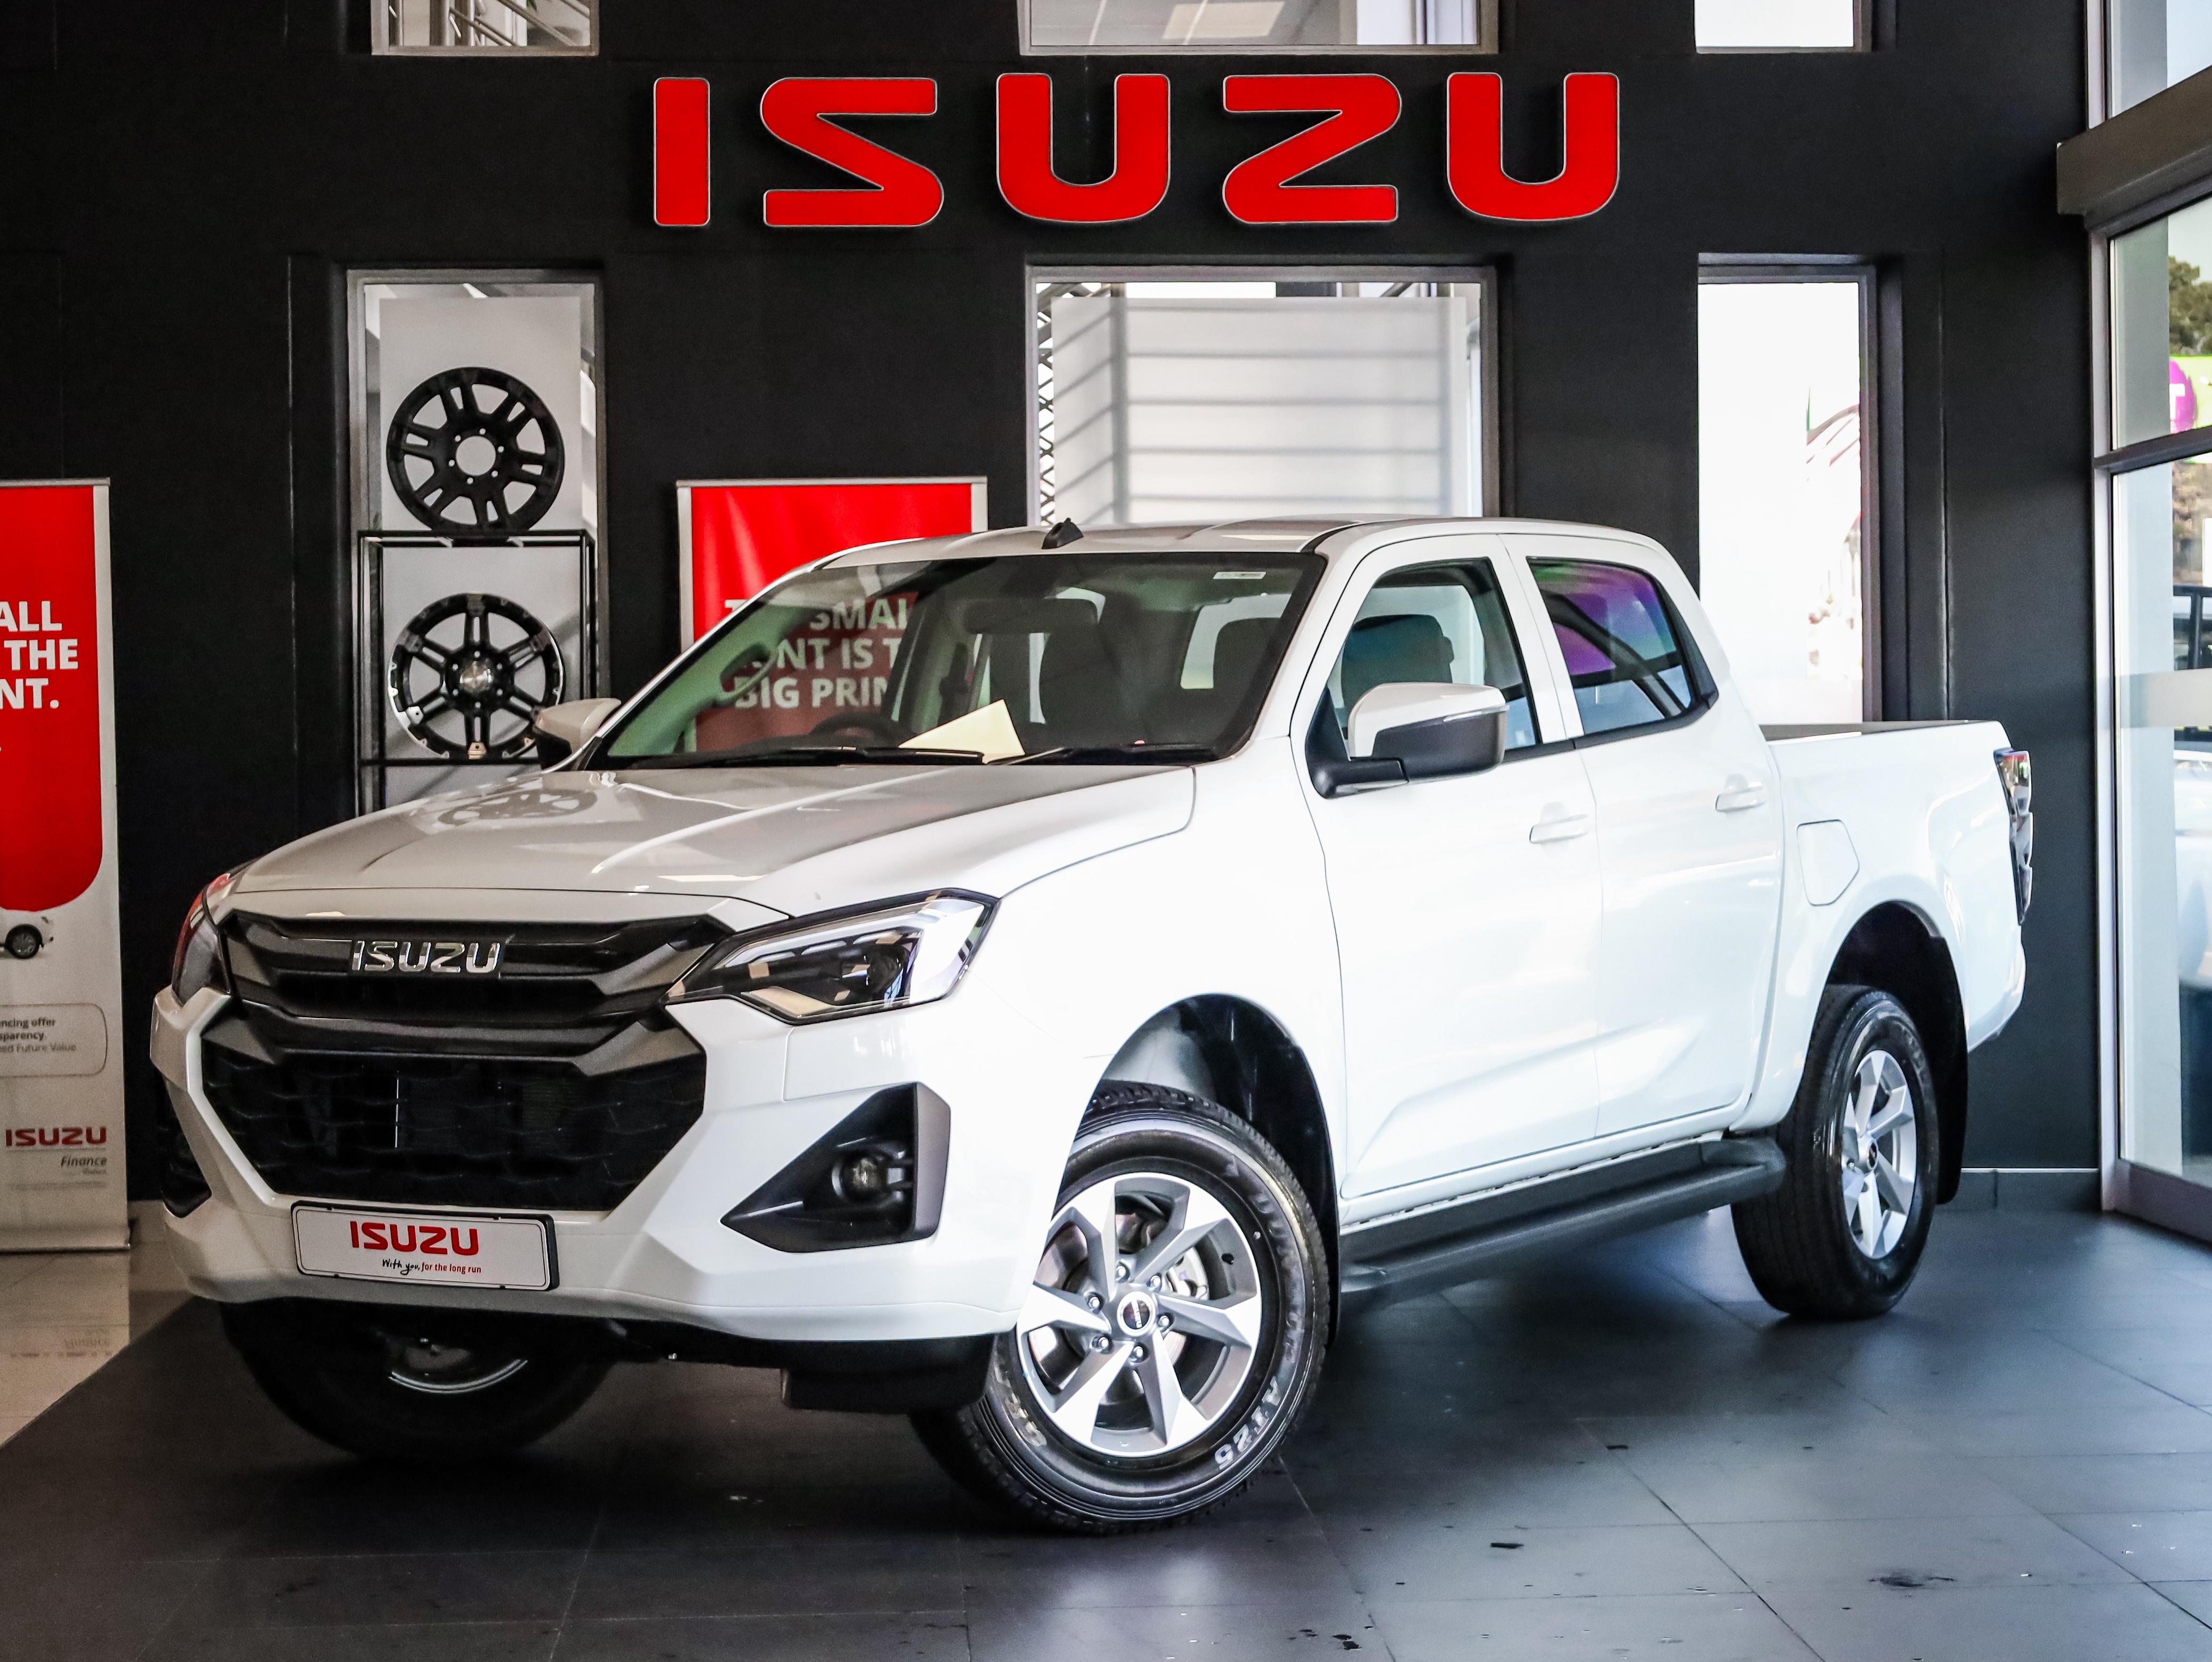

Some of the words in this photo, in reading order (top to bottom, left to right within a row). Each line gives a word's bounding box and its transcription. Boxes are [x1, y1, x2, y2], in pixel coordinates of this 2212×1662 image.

[653, 72, 1620, 227] ISUZU
[4, 639, 79, 670] THE
[841, 638, 874, 669] IS
[734, 676, 800, 709] BIG
[351, 940, 501, 973] ISUZU
[0, 1018, 29, 1029] ncing
[31, 1017, 56, 1027] offer
[50, 1042, 77, 1052] Value
[5, 1126, 106, 1146] ISUZU
[61, 1155, 107, 1168] Finance
[350, 1221, 479, 1256] ISUZU
[382, 1258, 403, 1270] With
[421, 1262, 433, 1272] for
[434, 1263, 448, 1271] the
[449, 1263, 466, 1275] long
